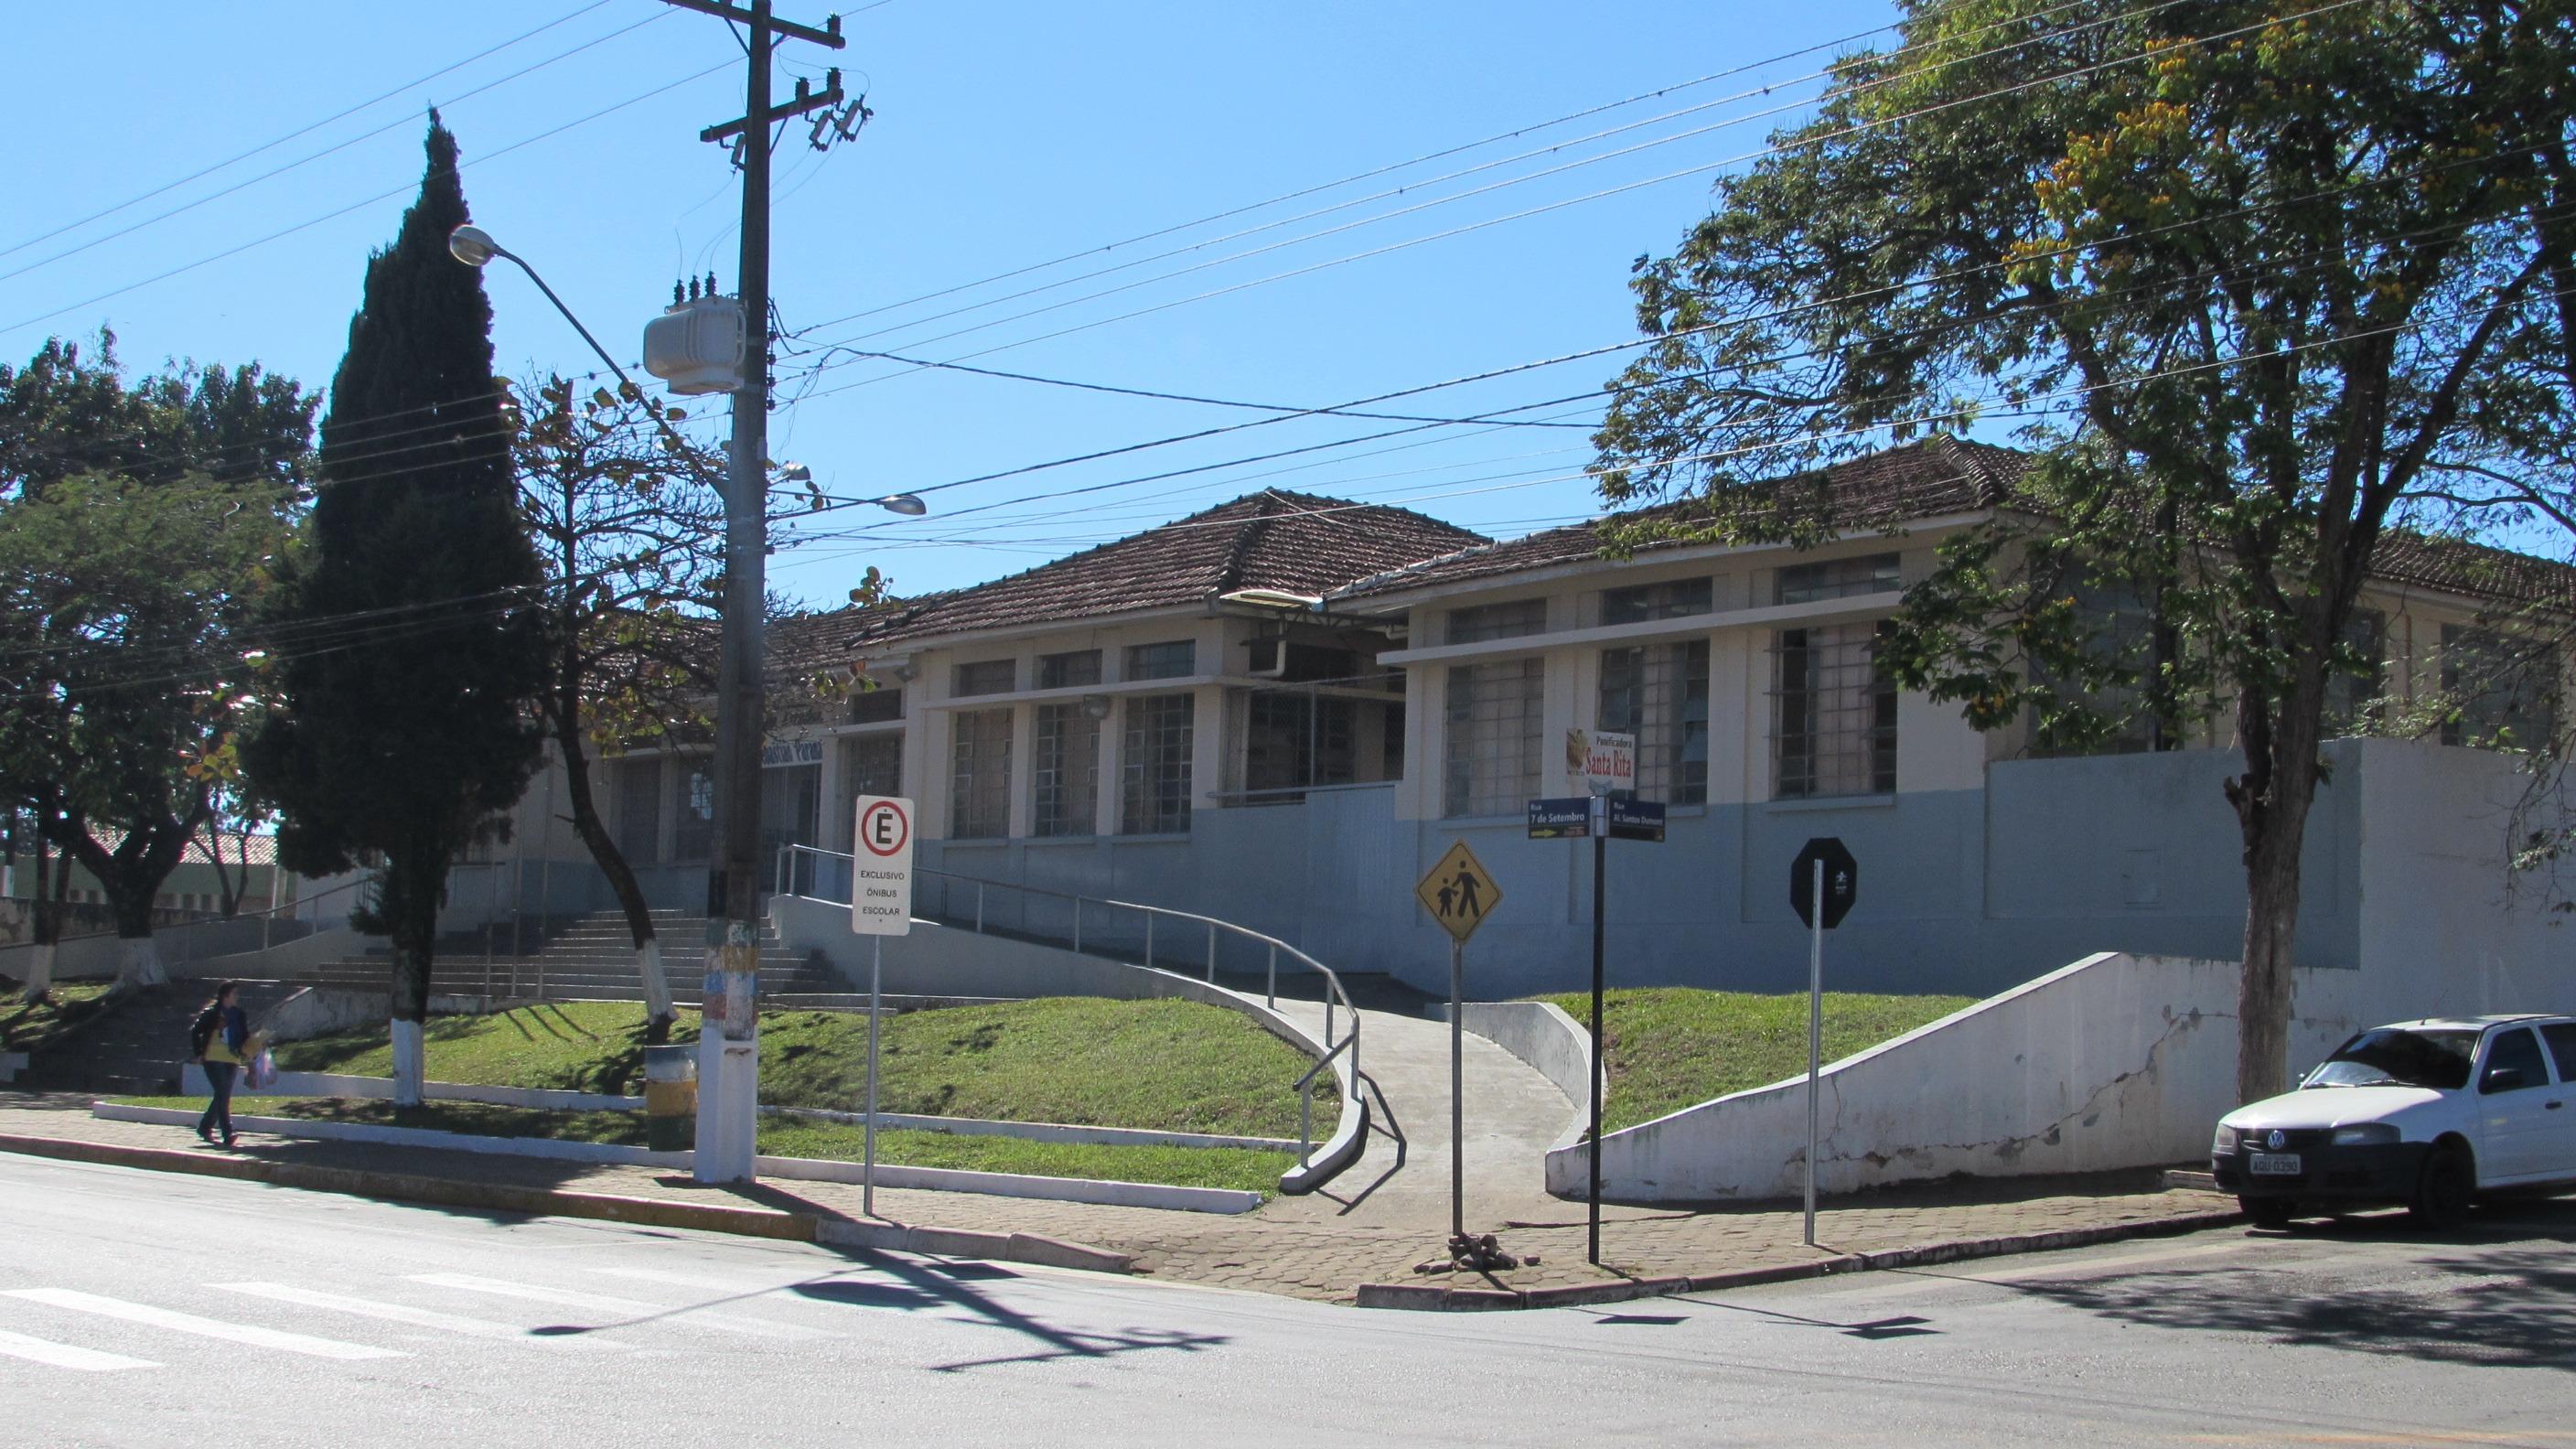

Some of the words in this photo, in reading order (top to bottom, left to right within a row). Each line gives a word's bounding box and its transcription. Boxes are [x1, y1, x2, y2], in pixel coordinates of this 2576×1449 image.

[1596, 735, 1632, 748] Panificadora
[1585, 746, 1611, 775] Santa
[1613, 749, 1632, 778] Rita
[1613, 801, 1625, 810] Rua
[1530, 815, 1536, 823] 7
[1537, 814, 1547, 822] de
[1548, 812, 1585, 822] Setembro
[1622, 814, 1640, 823] Santos
[1641, 815, 1663, 825] Dumont
[875, 812, 894, 844] E
[860, 870, 905, 880] EXCLUSIVO
[866, 888, 897, 897] ÔNIBUS
[863, 906, 900, 915] ESCOLAR
